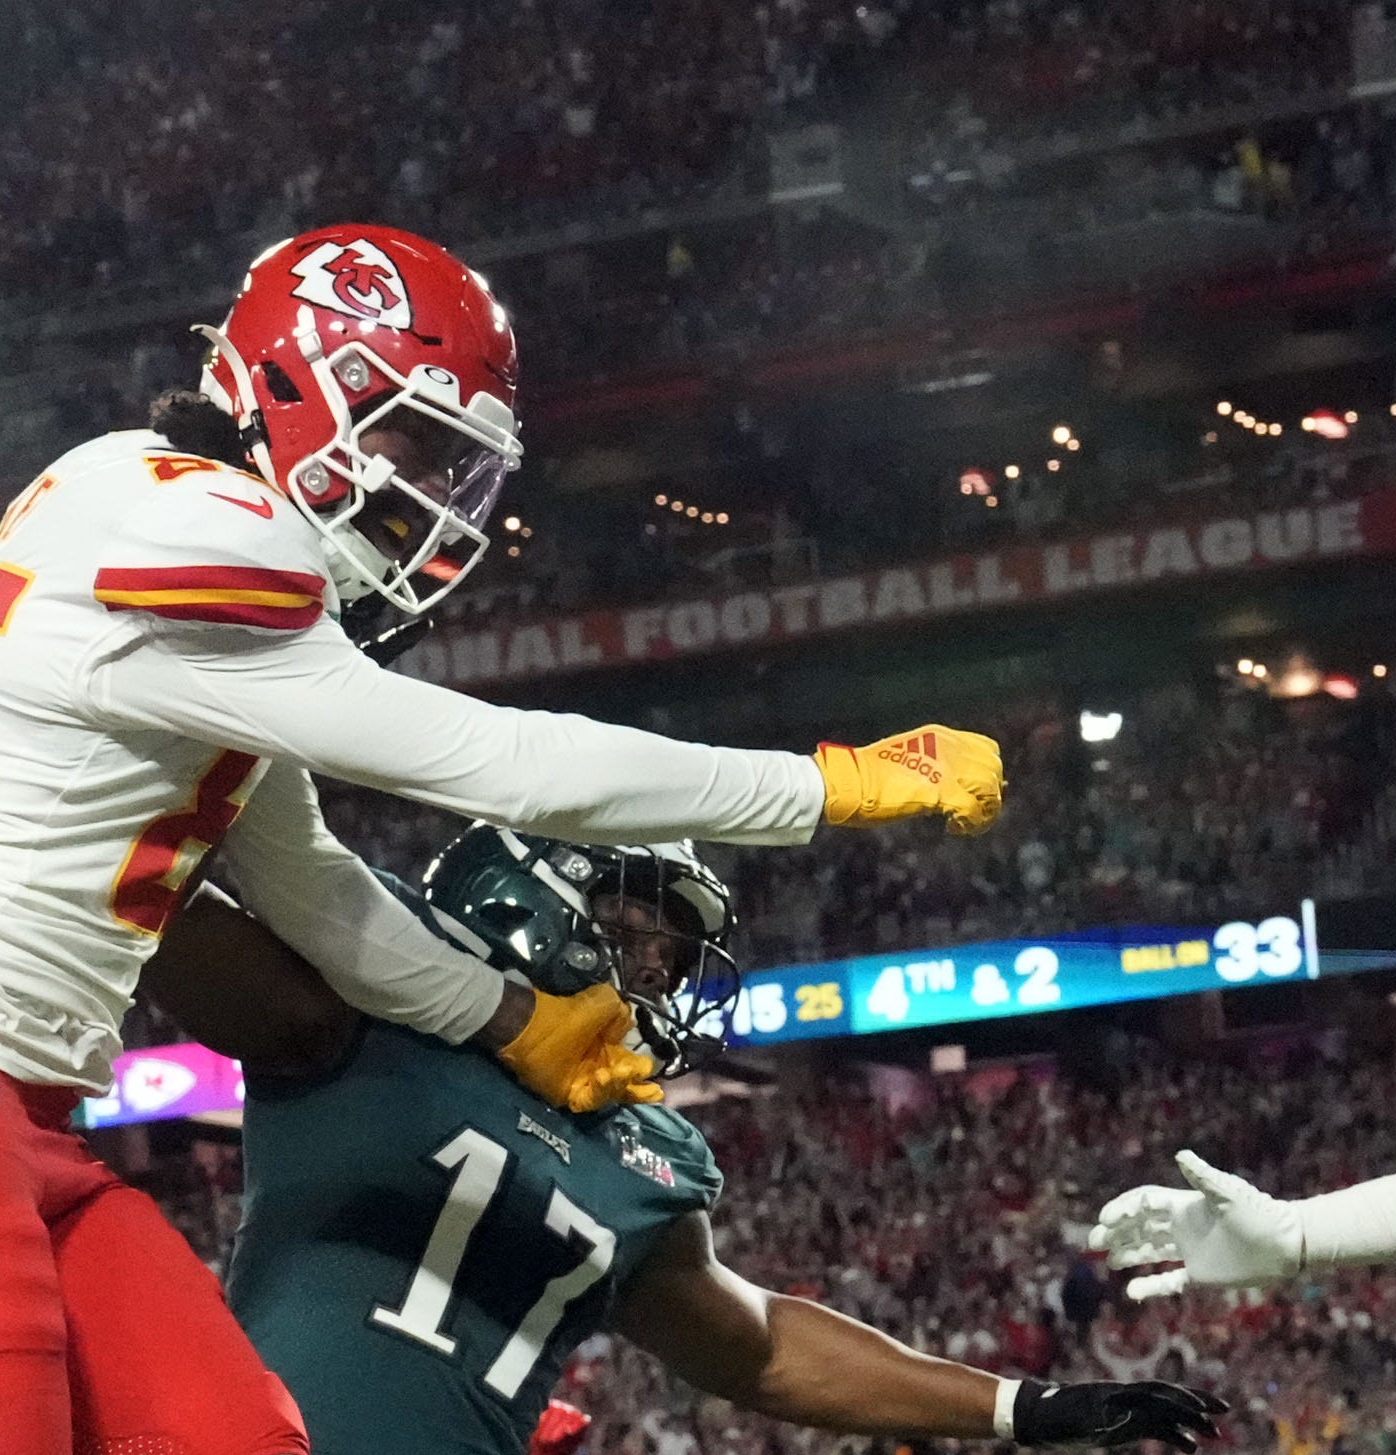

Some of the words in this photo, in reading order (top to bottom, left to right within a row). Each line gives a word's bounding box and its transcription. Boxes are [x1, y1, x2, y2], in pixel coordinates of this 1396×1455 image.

[320, 248, 402, 319] KC
[391, 616, 602, 682] ONAL
[622, 556, 1022, 659] FOOTBALL
[1044, 503, 1365, 594] LEAGUE
[878, 750, 942, 784] adidas
[795, 982, 844, 1022] 25
[867, 959, 957, 1022] 4TH
[971, 964, 1011, 1006] &
[1014, 946, 1062, 1006] 2
[1214, 916, 1303, 982] 33
[372, 1127, 617, 1399] 17
